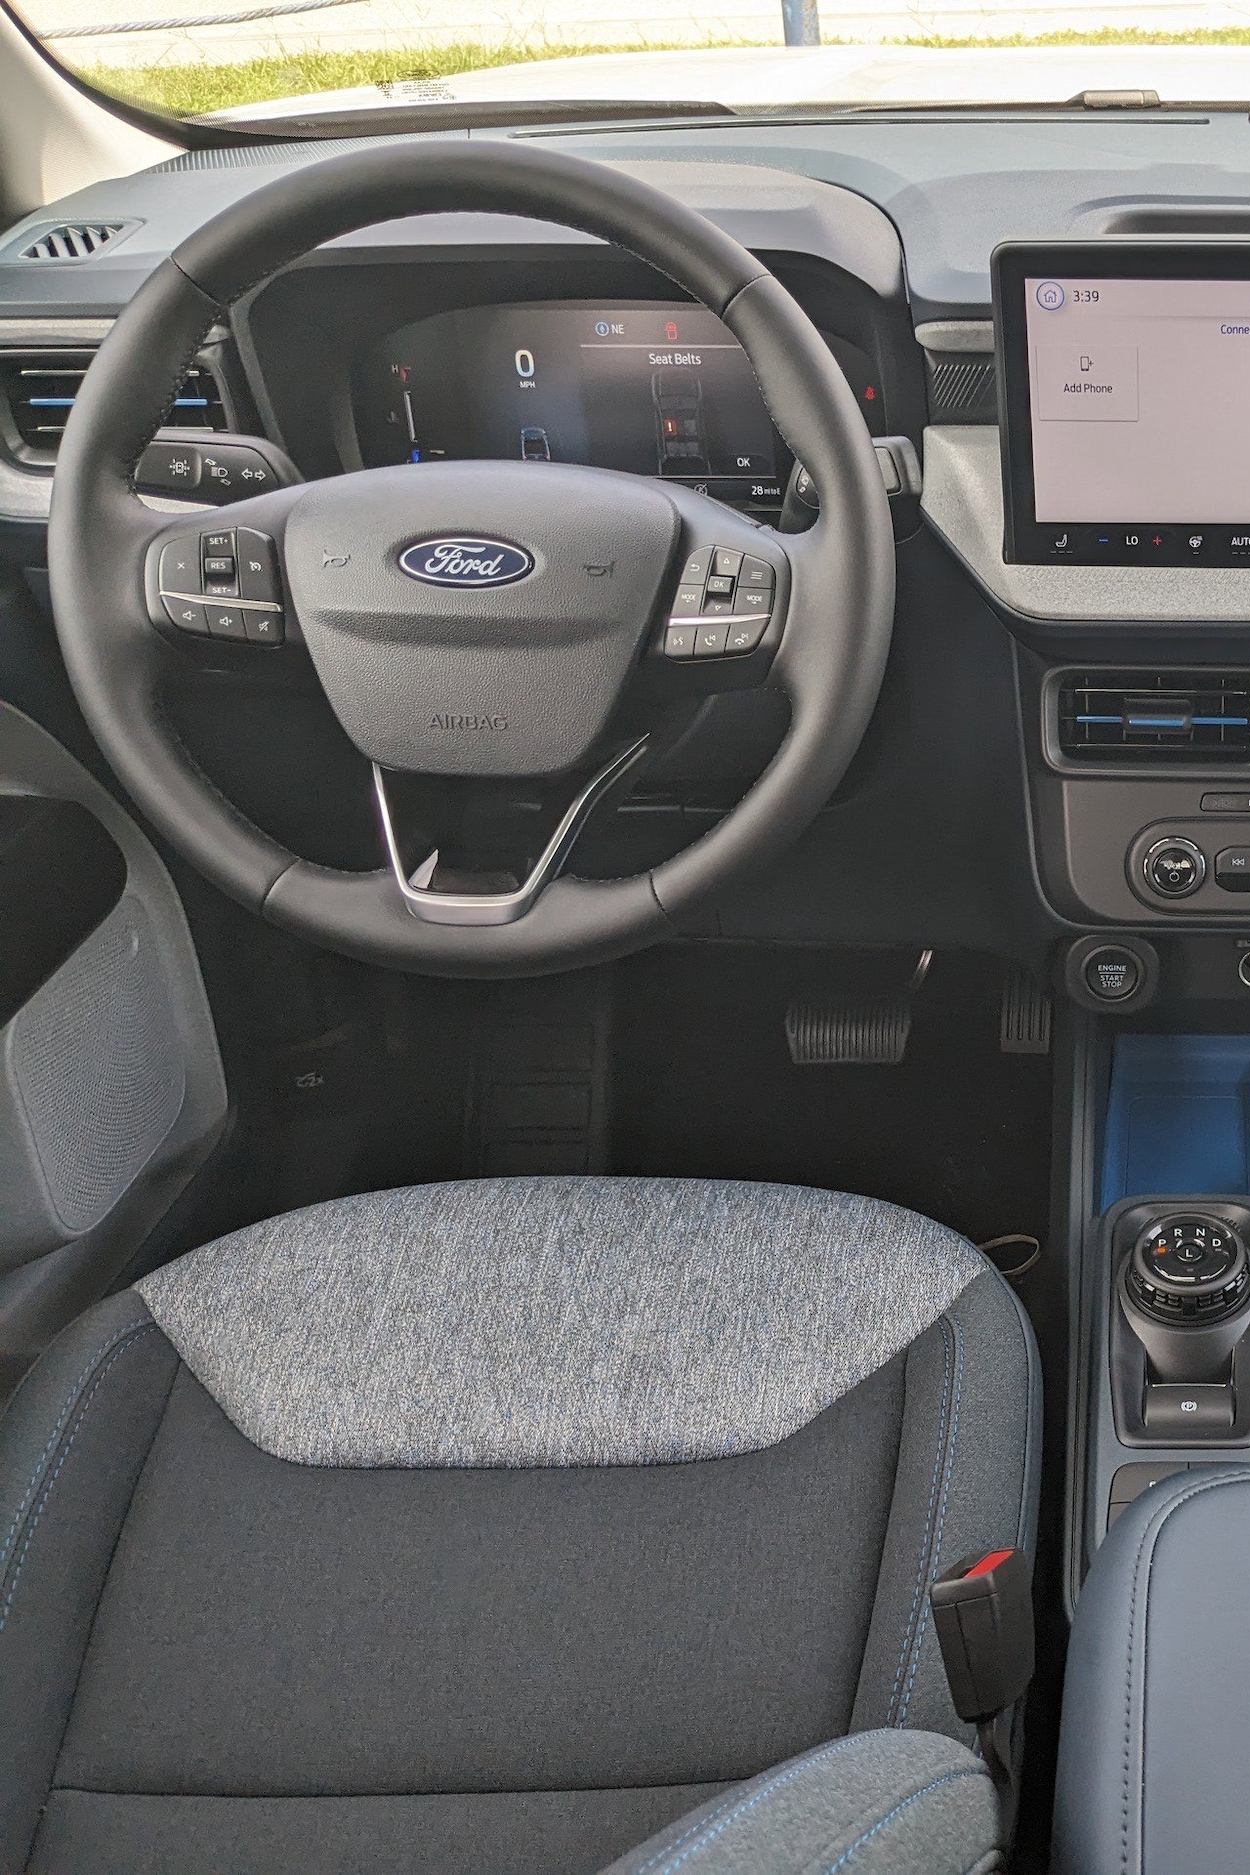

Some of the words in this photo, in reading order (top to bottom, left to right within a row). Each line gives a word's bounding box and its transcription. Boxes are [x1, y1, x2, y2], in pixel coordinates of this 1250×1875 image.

[1073, 290, 1099, 302] 3:39
[611, 325, 625, 334] NE
[514, 349, 535, 378] 0
[649, 353, 673, 365] Seat
[674, 353, 702, 365] Belts
[391, 364, 399, 374] H
[519, 381, 536, 389] MPH
[1063, 383, 1082, 394] Add
[1083, 383, 1113, 394] Phone
[736, 458, 751, 467] OK
[751, 485, 764, 496] 28
[1125, 536, 1139, 546] LO
[424, 543, 505, 576] Ford
[210, 562, 226, 570] RES
[429, 713, 509, 731] AIRBAG
[1097, 964, 1127, 972] ENGINE
[1100, 974, 1124, 982] START
[1101, 980, 1122, 988] STOP
[1158, 1239, 1167, 1247] P
[1174, 1228, 1183, 1237] R
[1196, 1228, 1206, 1237] N
[1212, 1238, 1222, 1247] D
[1185, 1249, 1193, 1258] L
